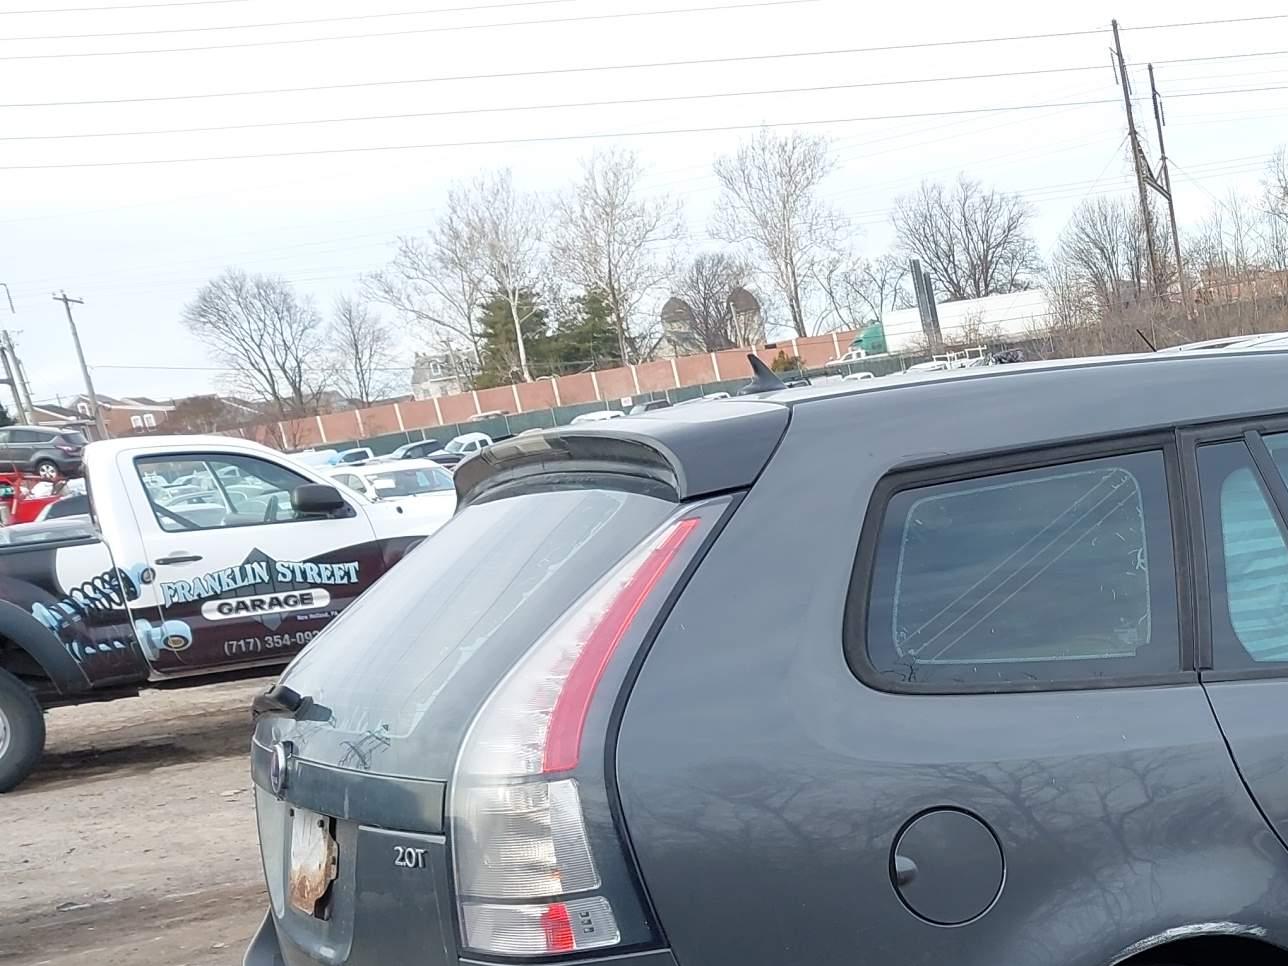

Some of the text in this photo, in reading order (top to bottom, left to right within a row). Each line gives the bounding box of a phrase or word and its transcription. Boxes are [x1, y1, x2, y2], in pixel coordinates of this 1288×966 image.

[160, 561, 359, 608] FRANKLIN STREET
[217, 592, 314, 616] GARAGE
[224, 637, 261, 656] (717)
